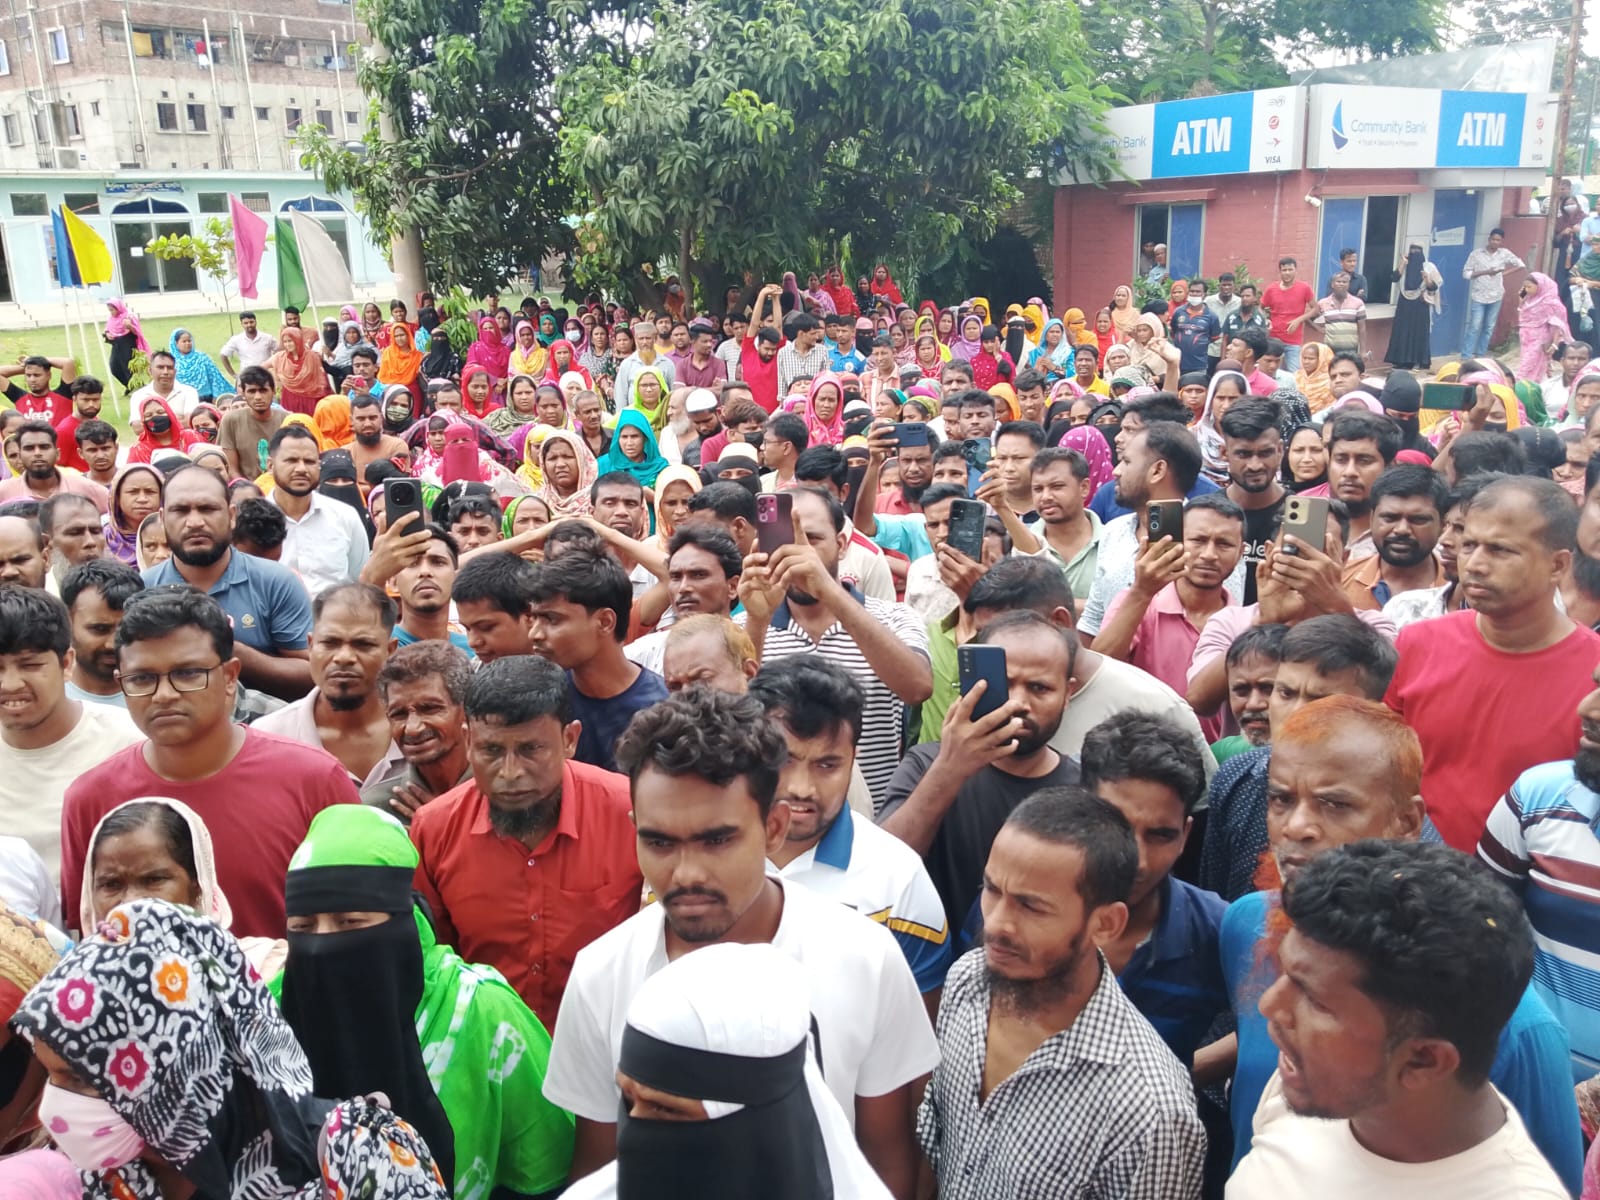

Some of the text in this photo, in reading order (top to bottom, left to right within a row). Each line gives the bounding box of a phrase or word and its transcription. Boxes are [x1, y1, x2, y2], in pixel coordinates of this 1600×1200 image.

[1171, 116, 1232, 156] ATM
[1351, 119, 1427, 136] Community Bank
[1456, 112, 1507, 147] ATM
[1123, 135, 1147, 149] Bank
[1264, 154, 1281, 165] VISA
